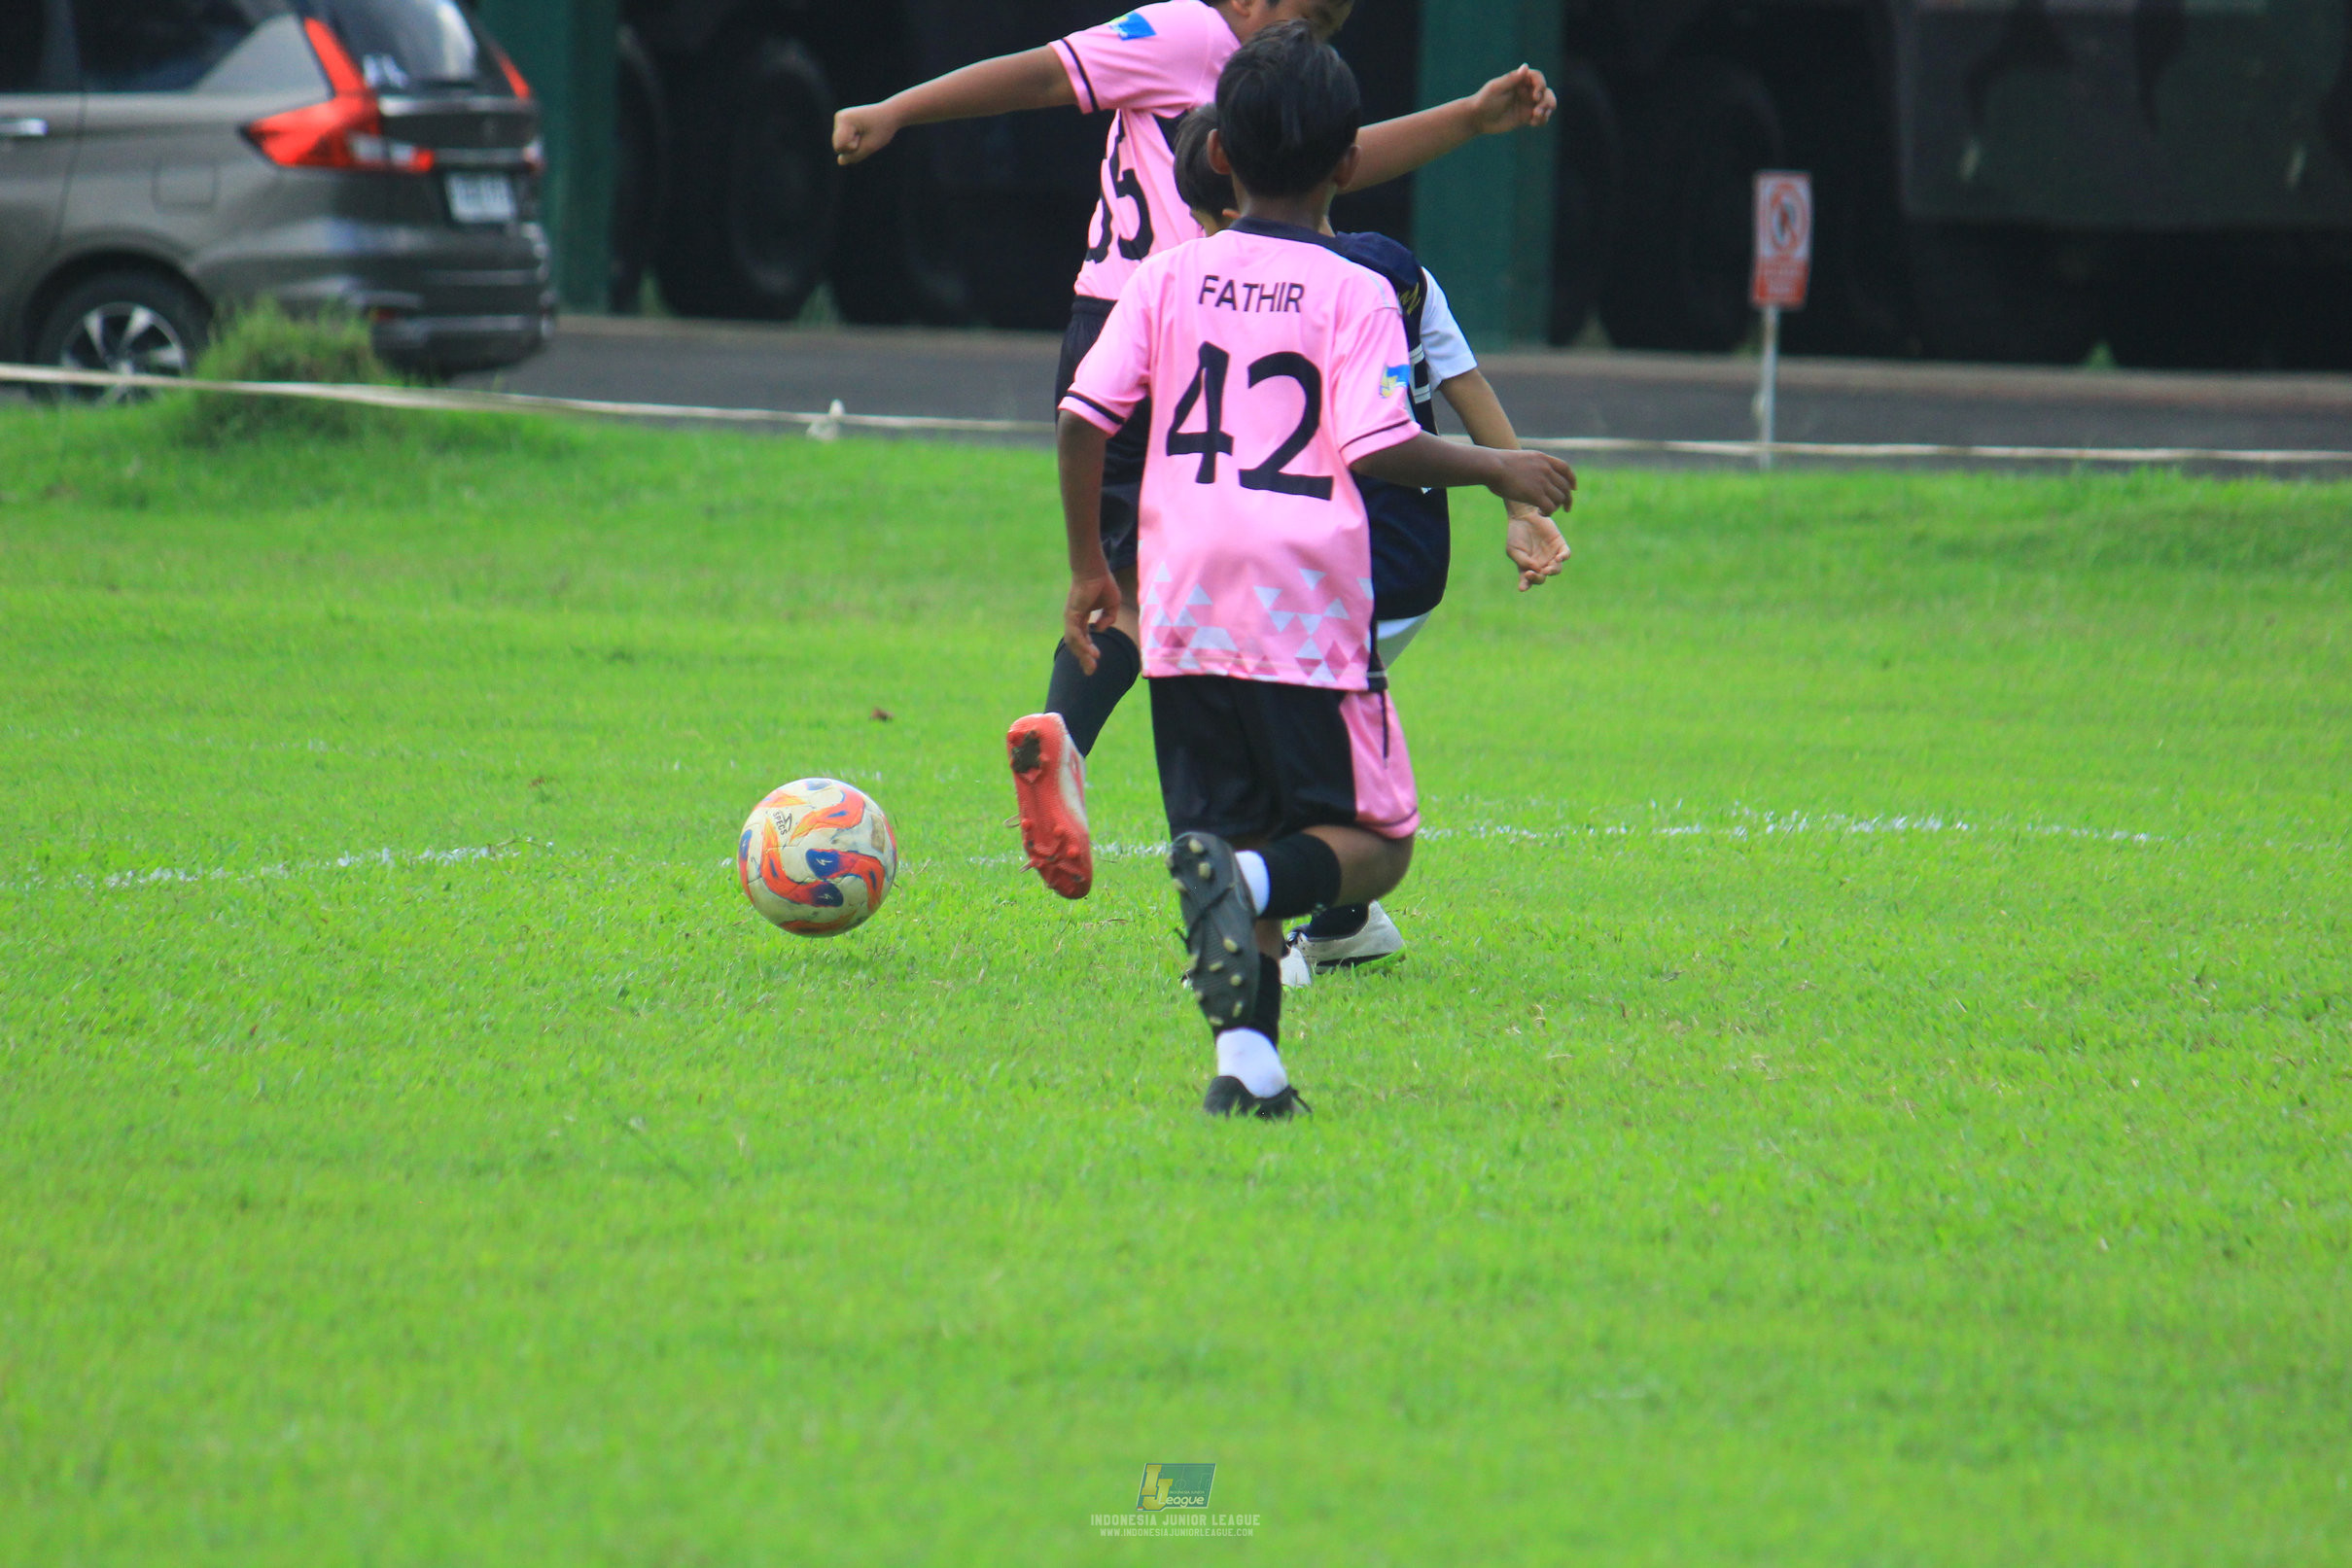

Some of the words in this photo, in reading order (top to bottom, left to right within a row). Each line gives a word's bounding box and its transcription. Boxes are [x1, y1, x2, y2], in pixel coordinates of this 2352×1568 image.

[1198, 274, 1305, 313] FATHIR
[1166, 340, 1334, 501] 42
[773, 811, 788, 835] SPECS
